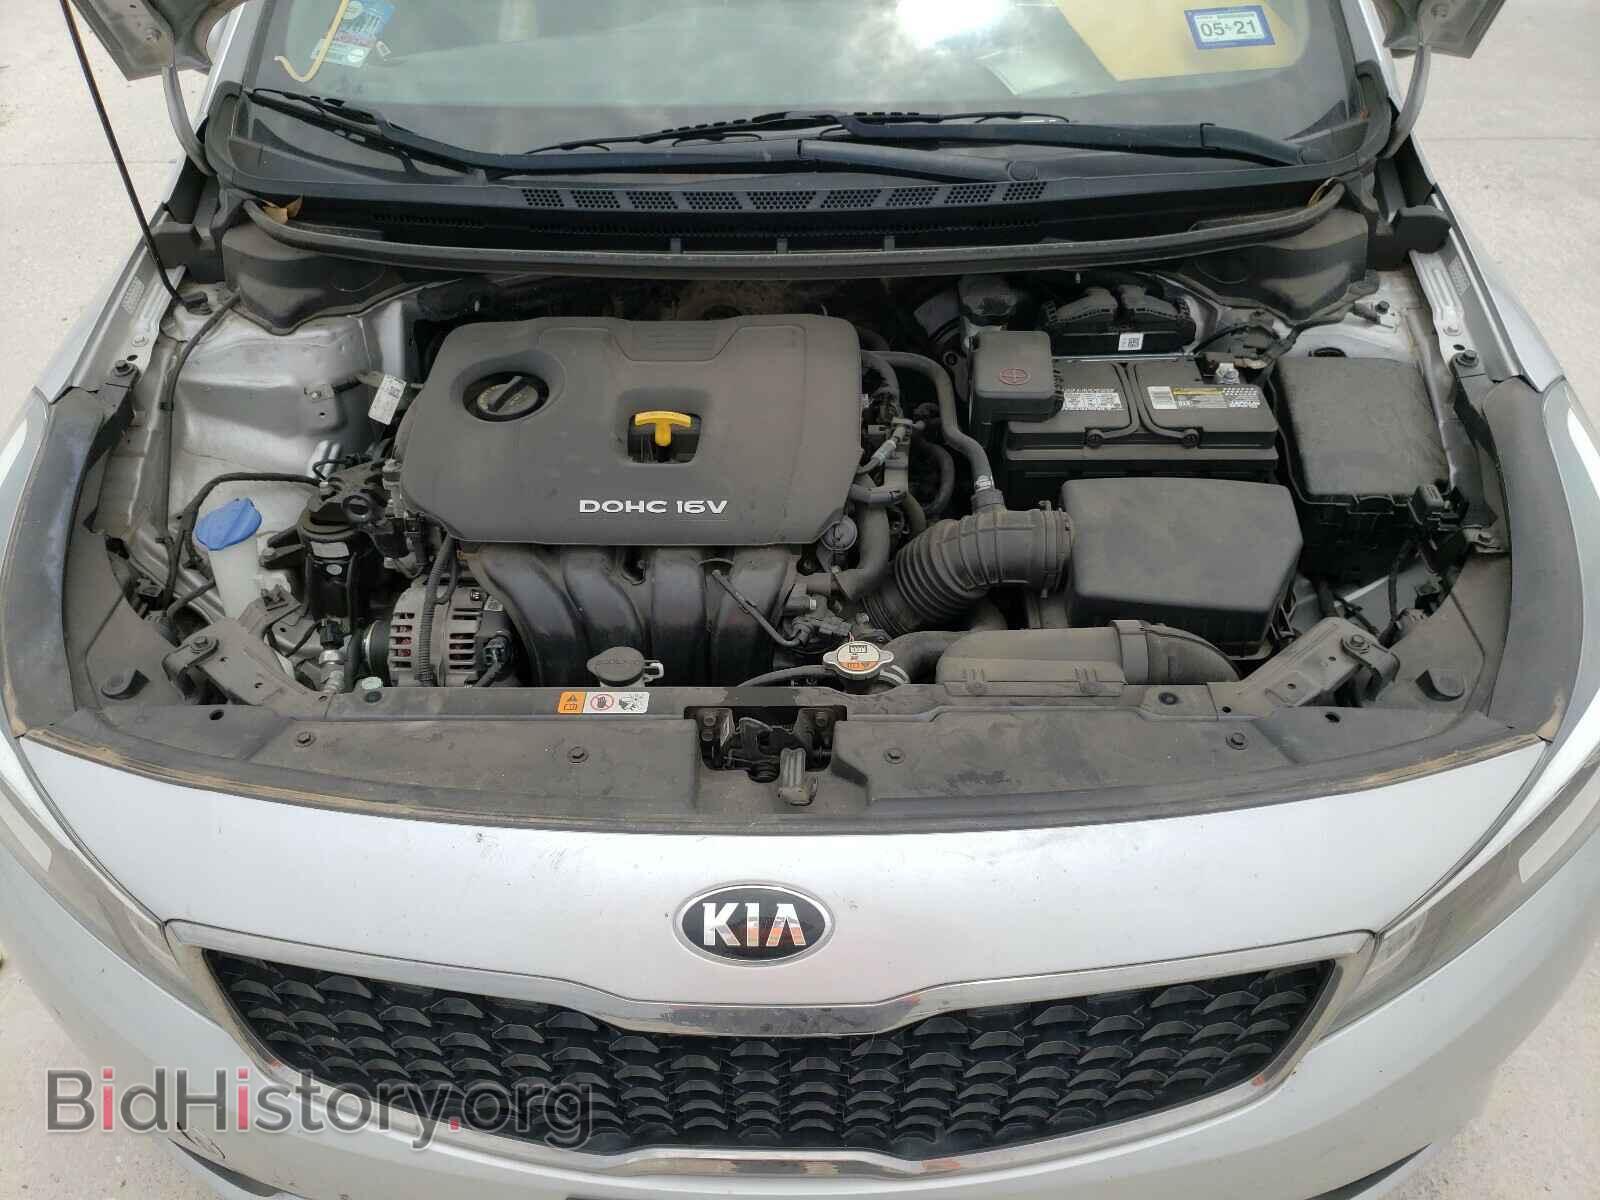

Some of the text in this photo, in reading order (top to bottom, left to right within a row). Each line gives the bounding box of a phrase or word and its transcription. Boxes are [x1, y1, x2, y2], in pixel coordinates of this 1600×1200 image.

[579, 499, 728, 514] DOHC 16V
[702, 902, 807, 947] KIA
